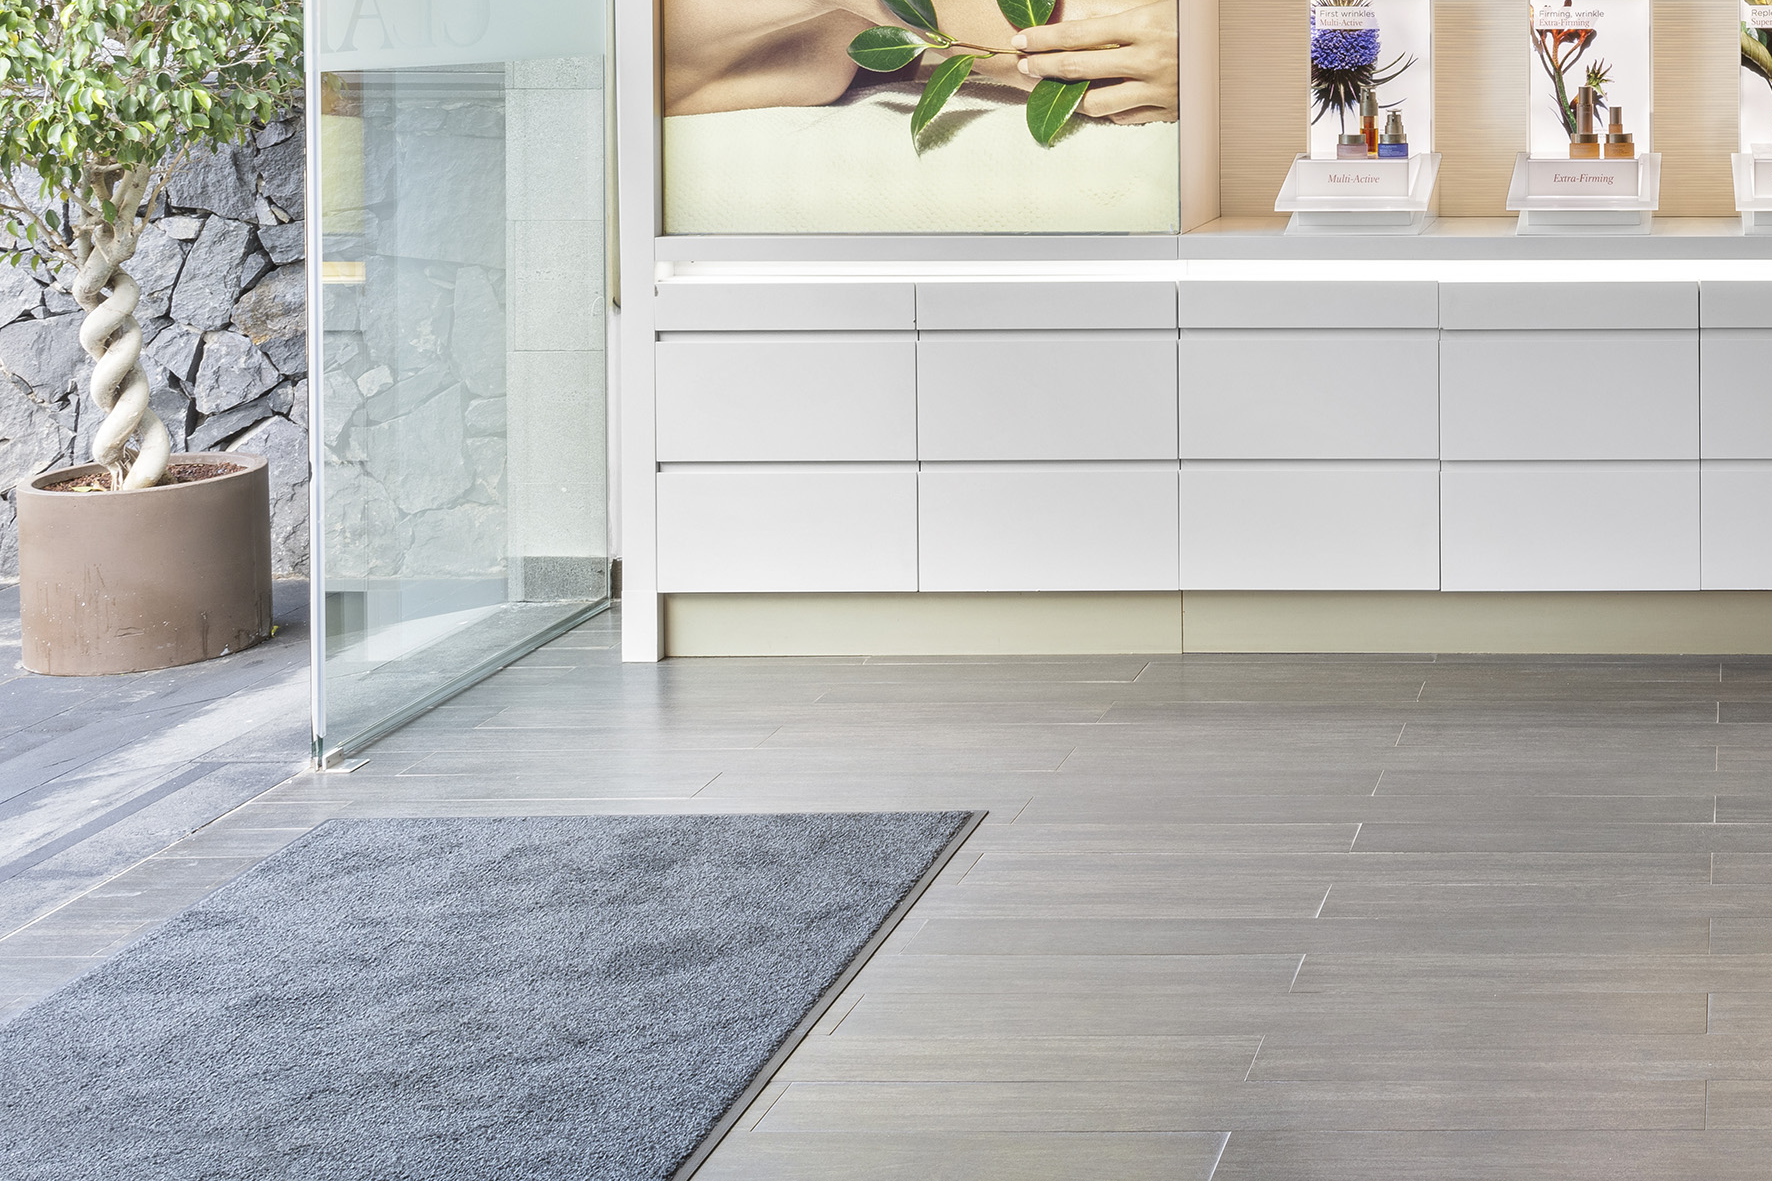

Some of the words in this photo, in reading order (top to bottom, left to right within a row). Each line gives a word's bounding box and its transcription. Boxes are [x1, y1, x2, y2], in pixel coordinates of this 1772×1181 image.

[1319, 10, 1339, 18] First
[1340, 10, 1376, 18] wrinkles
[1538, 9, 1573, 19] Firming,
[1574, 10, 1605, 18] wrinkle
[1319, 18, 1364, 27] Multi-Active
[1539, 18, 1591, 28] Extra-Firming
[1751, 18, 1772, 28] Super
[1327, 173, 1381, 184] Multi-Active
[1552, 173, 1615, 186] Extra-Firming
